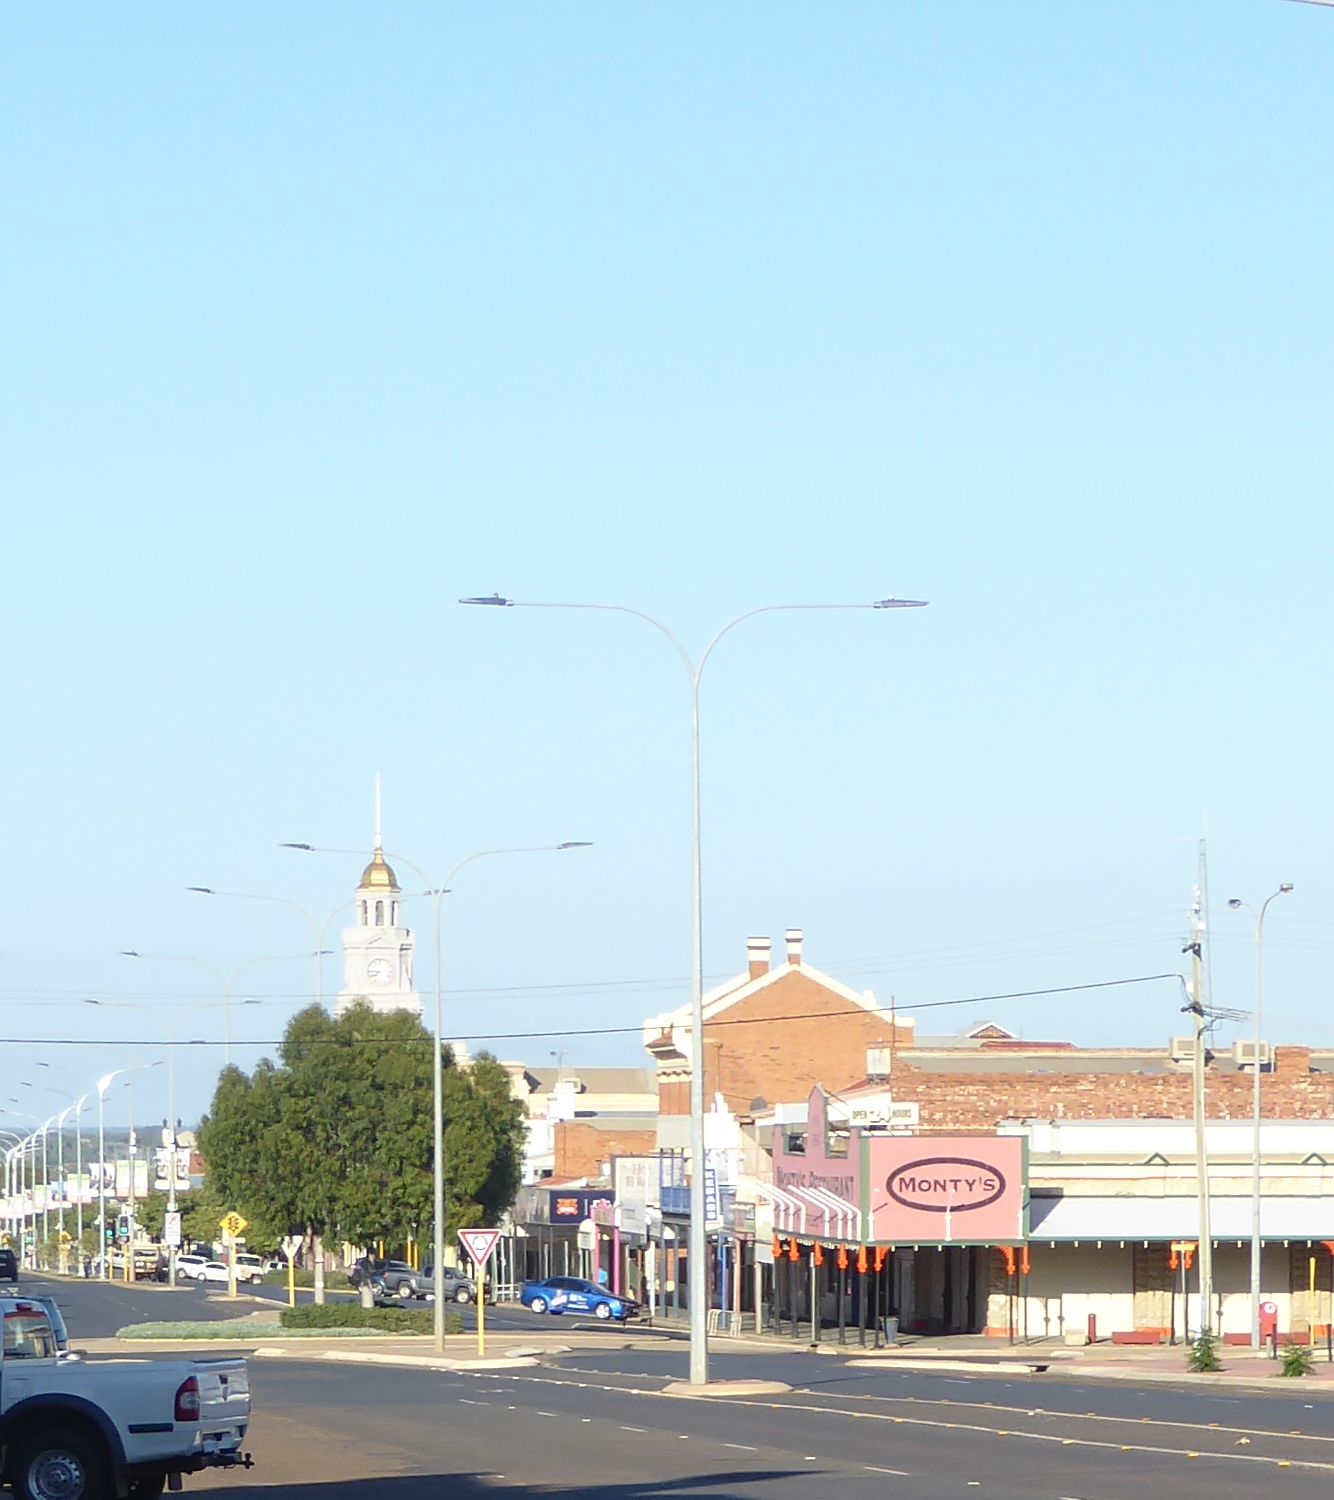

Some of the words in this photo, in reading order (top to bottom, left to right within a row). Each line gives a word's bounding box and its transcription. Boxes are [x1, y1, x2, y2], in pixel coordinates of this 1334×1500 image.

[852, 1110, 867, 1120] OPEN
[898, 1176, 996, 1193] MONTY'S
[704, 1170, 717, 1220] KEBABS
